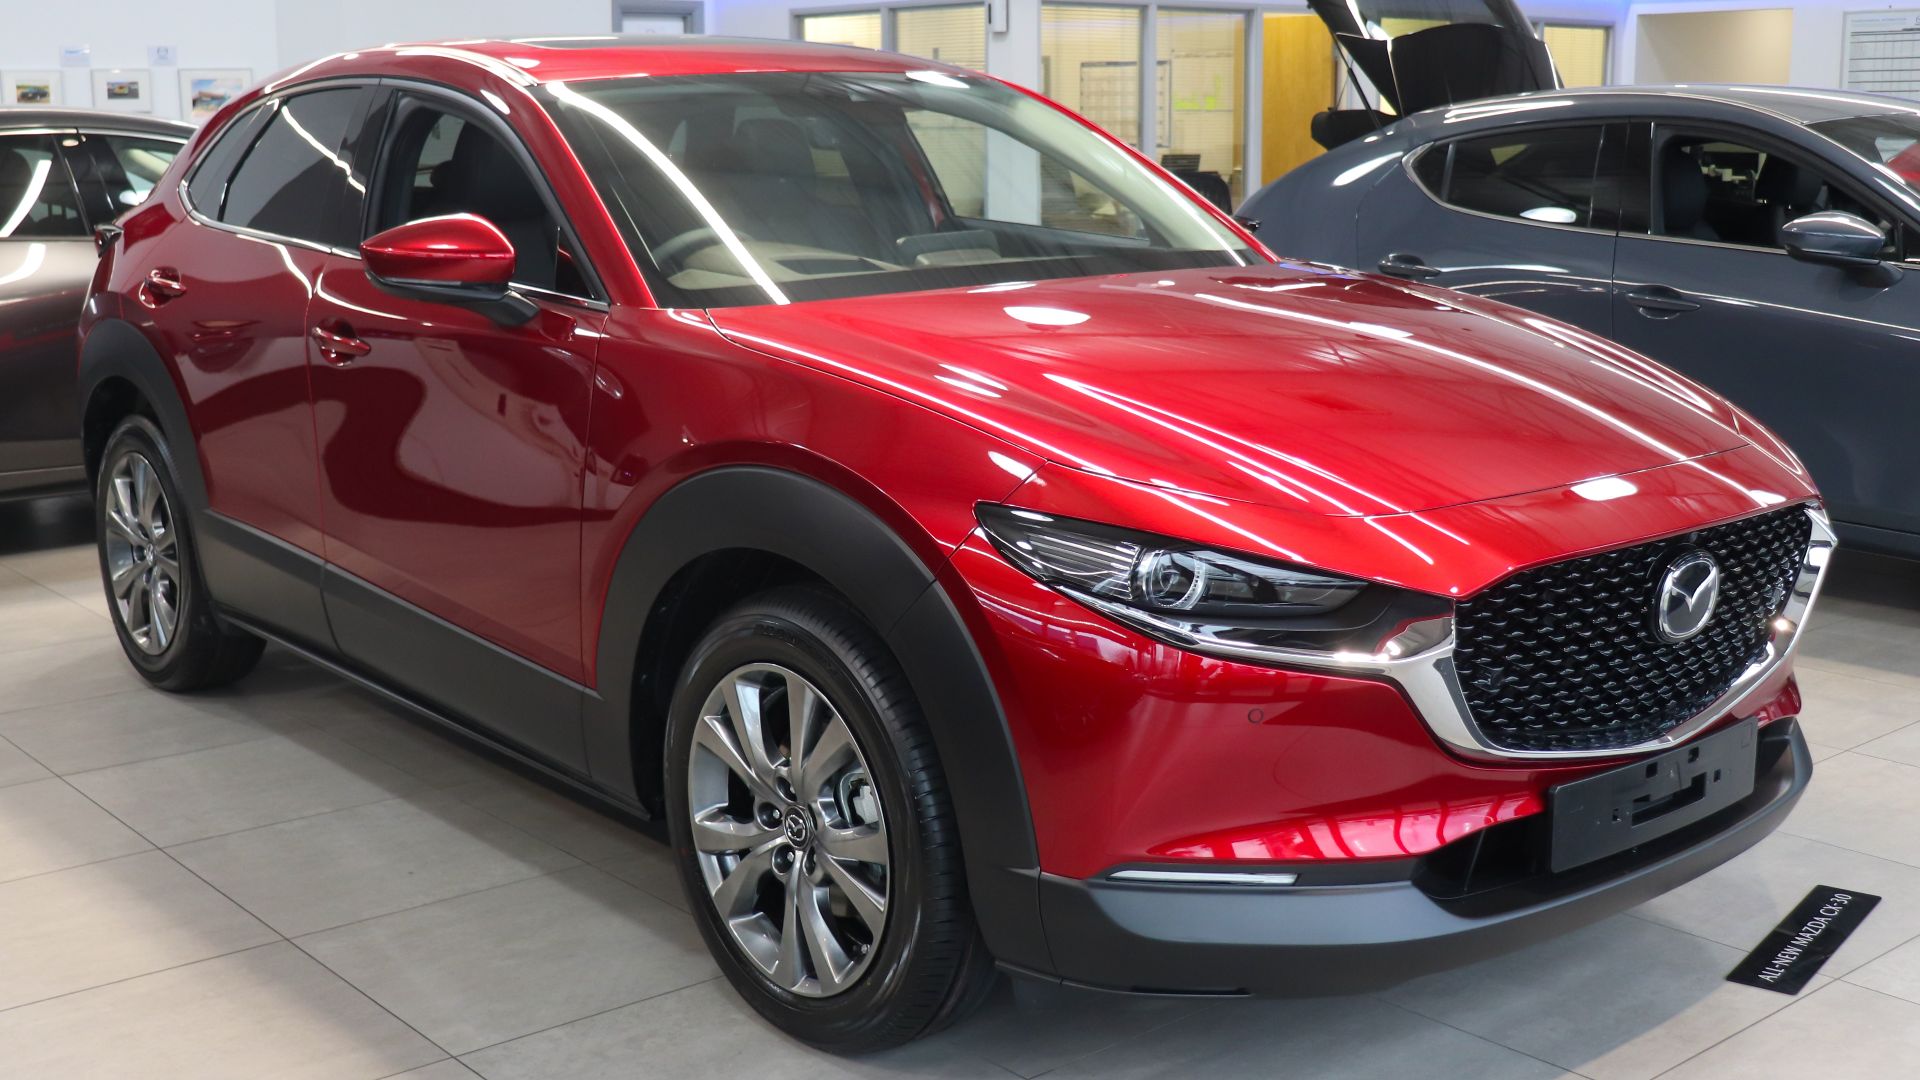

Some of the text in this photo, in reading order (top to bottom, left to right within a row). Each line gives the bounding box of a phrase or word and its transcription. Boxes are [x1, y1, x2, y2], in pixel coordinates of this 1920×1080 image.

[1758, 893, 1852, 982] ALL-NEW MAZDA CX-30
